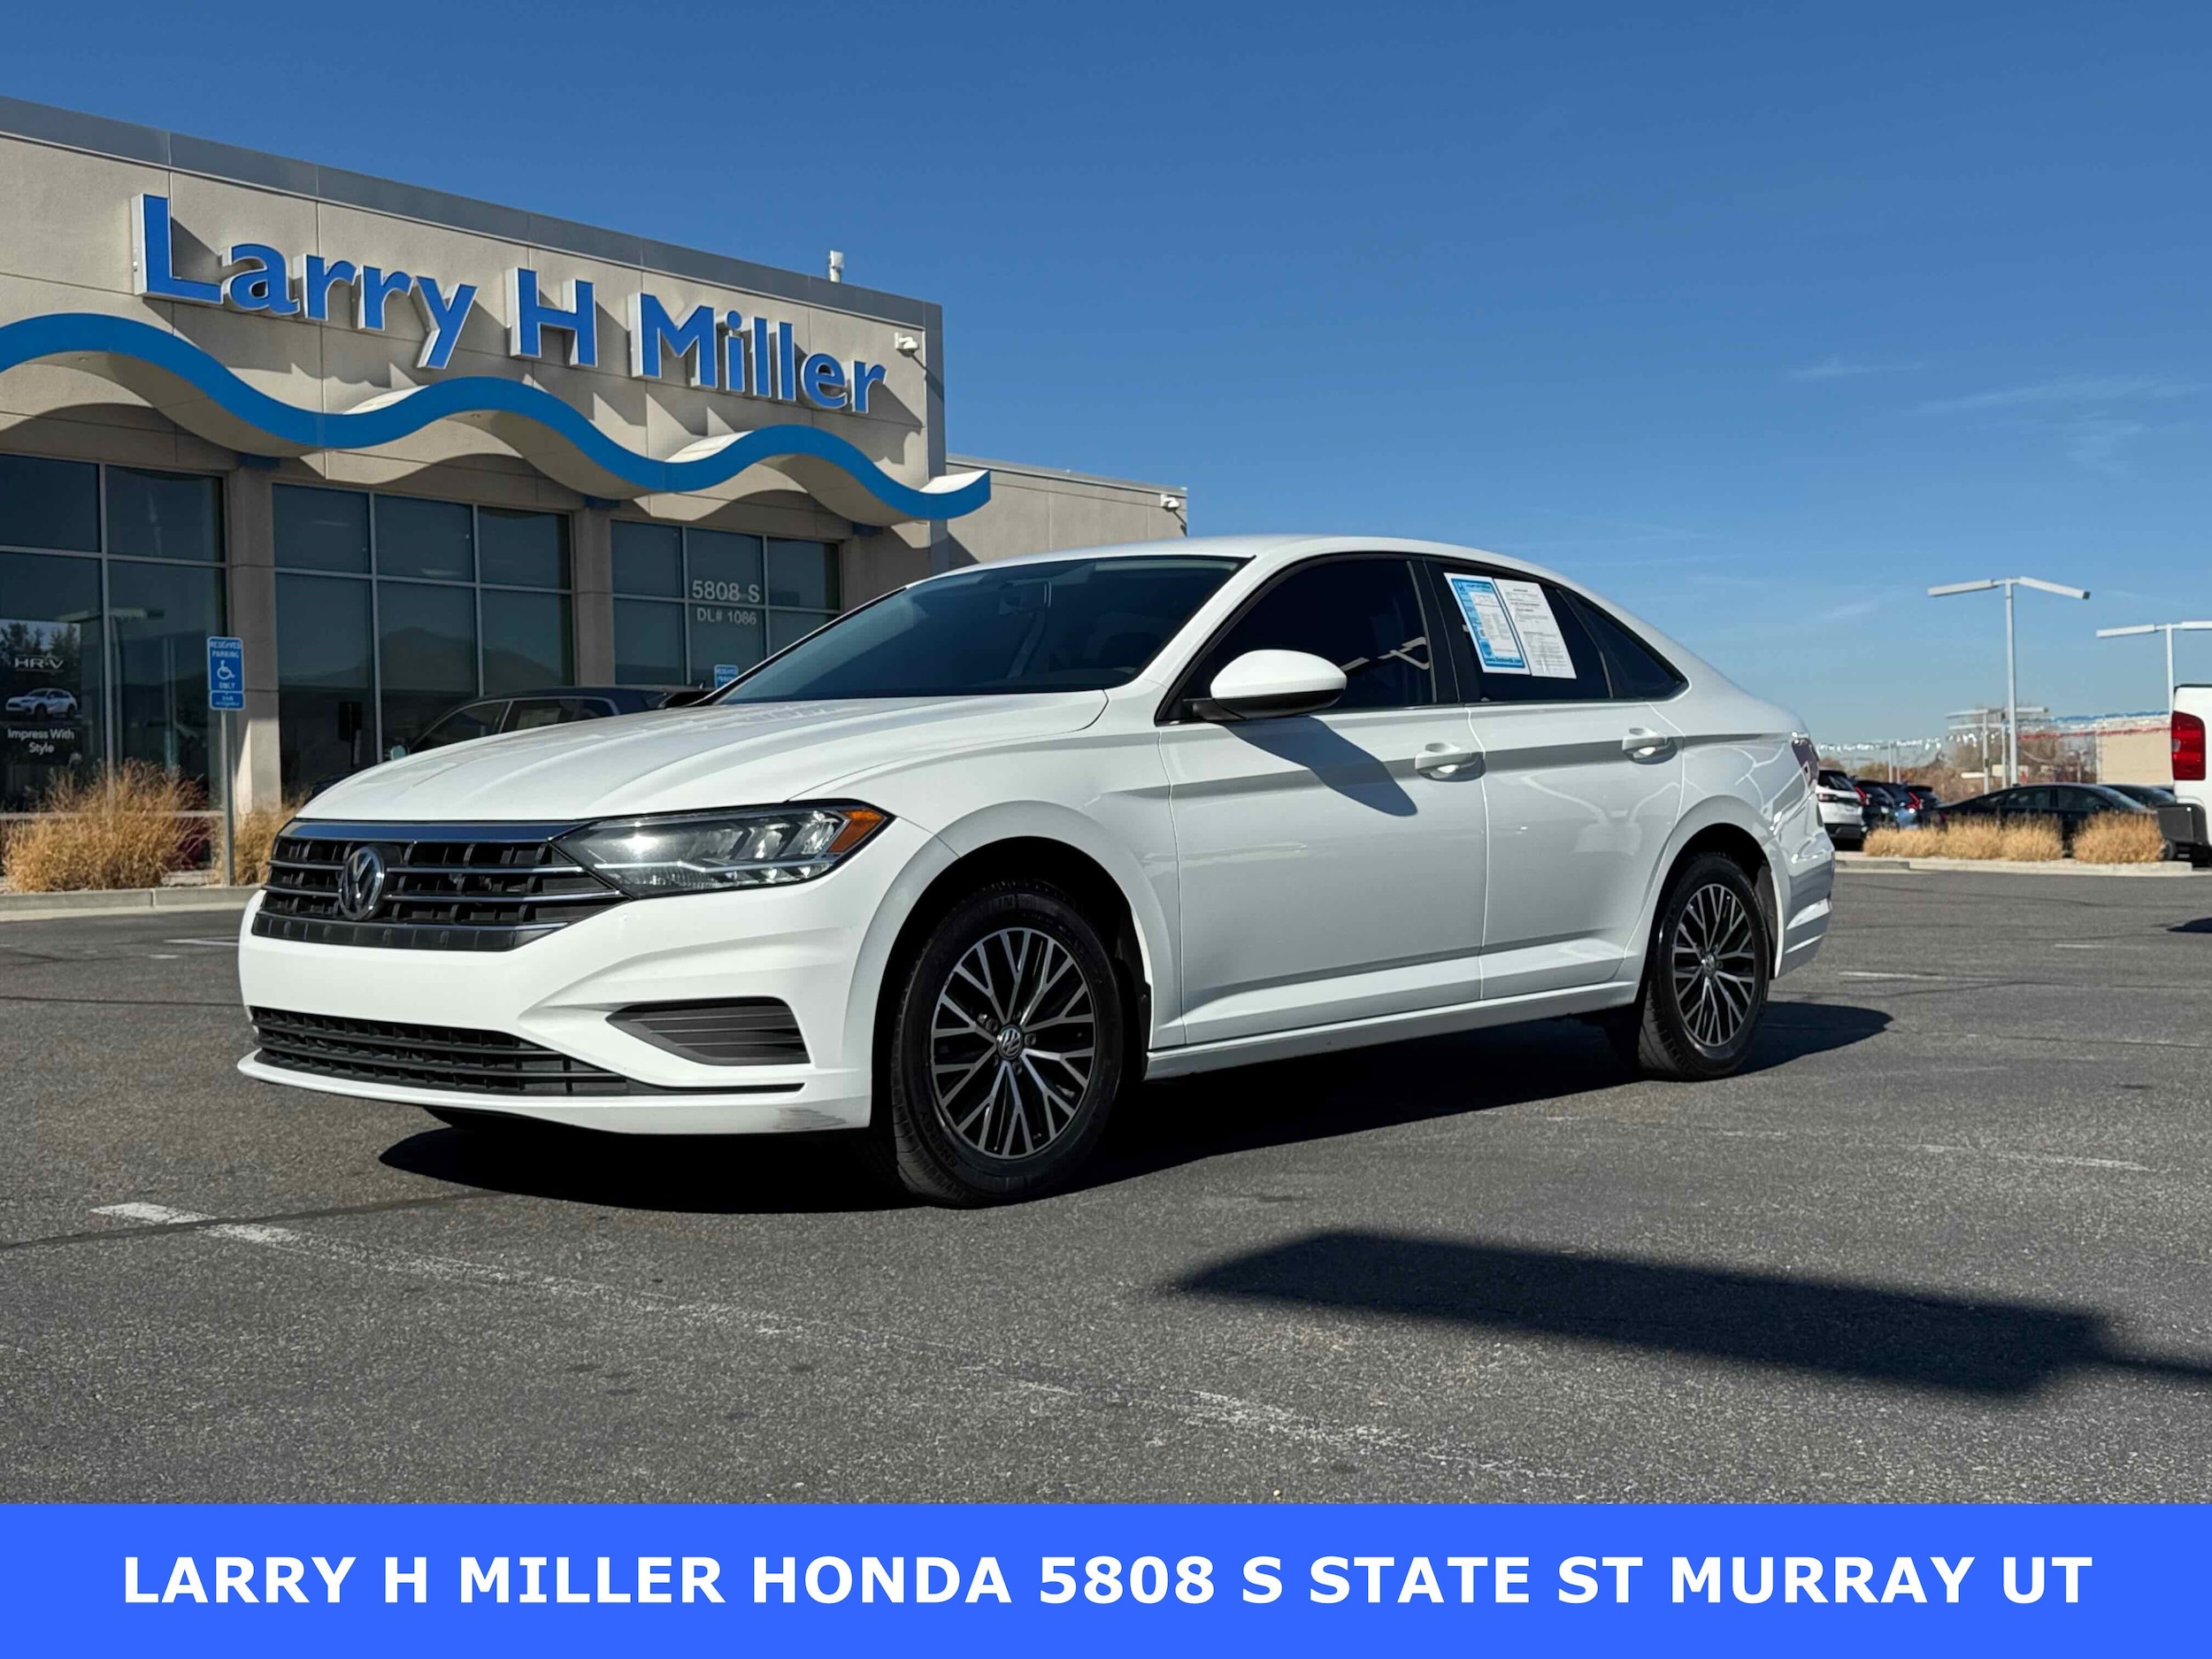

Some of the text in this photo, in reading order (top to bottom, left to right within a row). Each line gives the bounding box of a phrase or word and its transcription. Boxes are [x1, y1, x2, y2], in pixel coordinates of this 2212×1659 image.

[133, 193, 887, 414] Larry H Miller
[692, 580, 760, 603] 5808 S
[696, 607, 757, 626] DL# 1086
[211, 649, 240, 658] PARKING
[14, 657, 64, 669] HR-V
[7, 728, 74, 741] Impress With
[28, 741, 55, 756] Style
